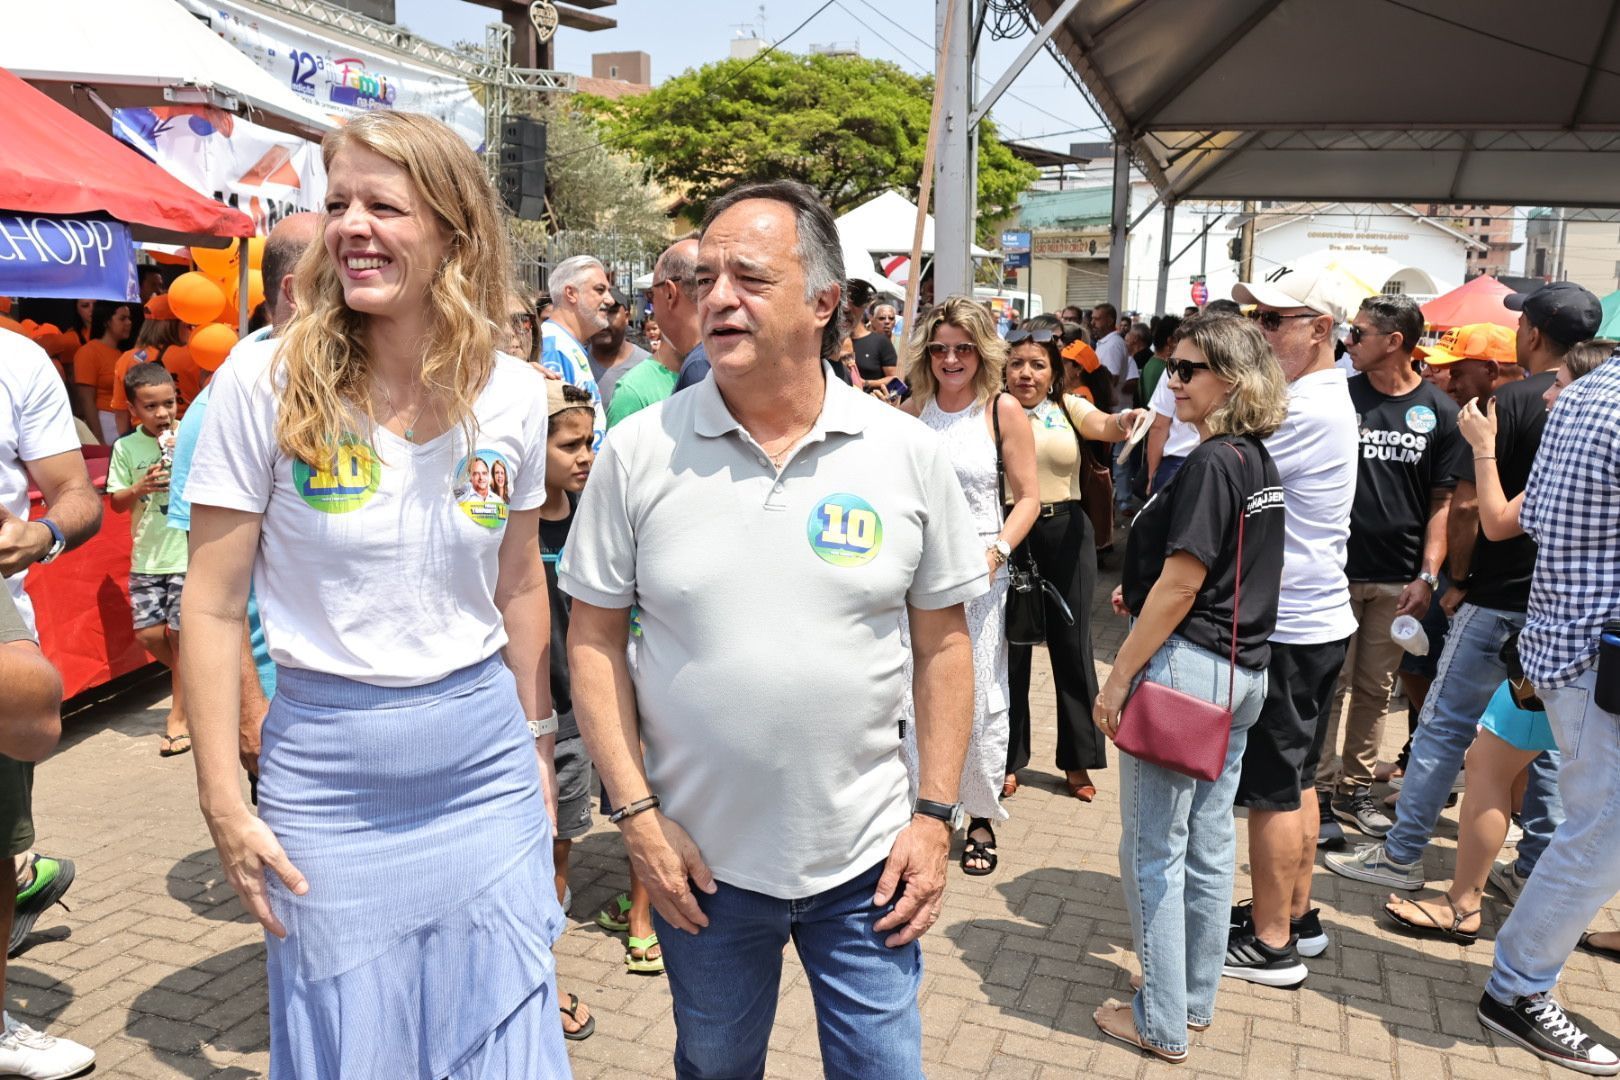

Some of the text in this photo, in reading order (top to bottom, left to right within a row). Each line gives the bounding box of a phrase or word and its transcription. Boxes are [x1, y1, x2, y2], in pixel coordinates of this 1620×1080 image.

[0, 217, 112, 267] HOPP
[1359, 428, 1427, 451] MIGOS
[818, 503, 877, 550] 10
